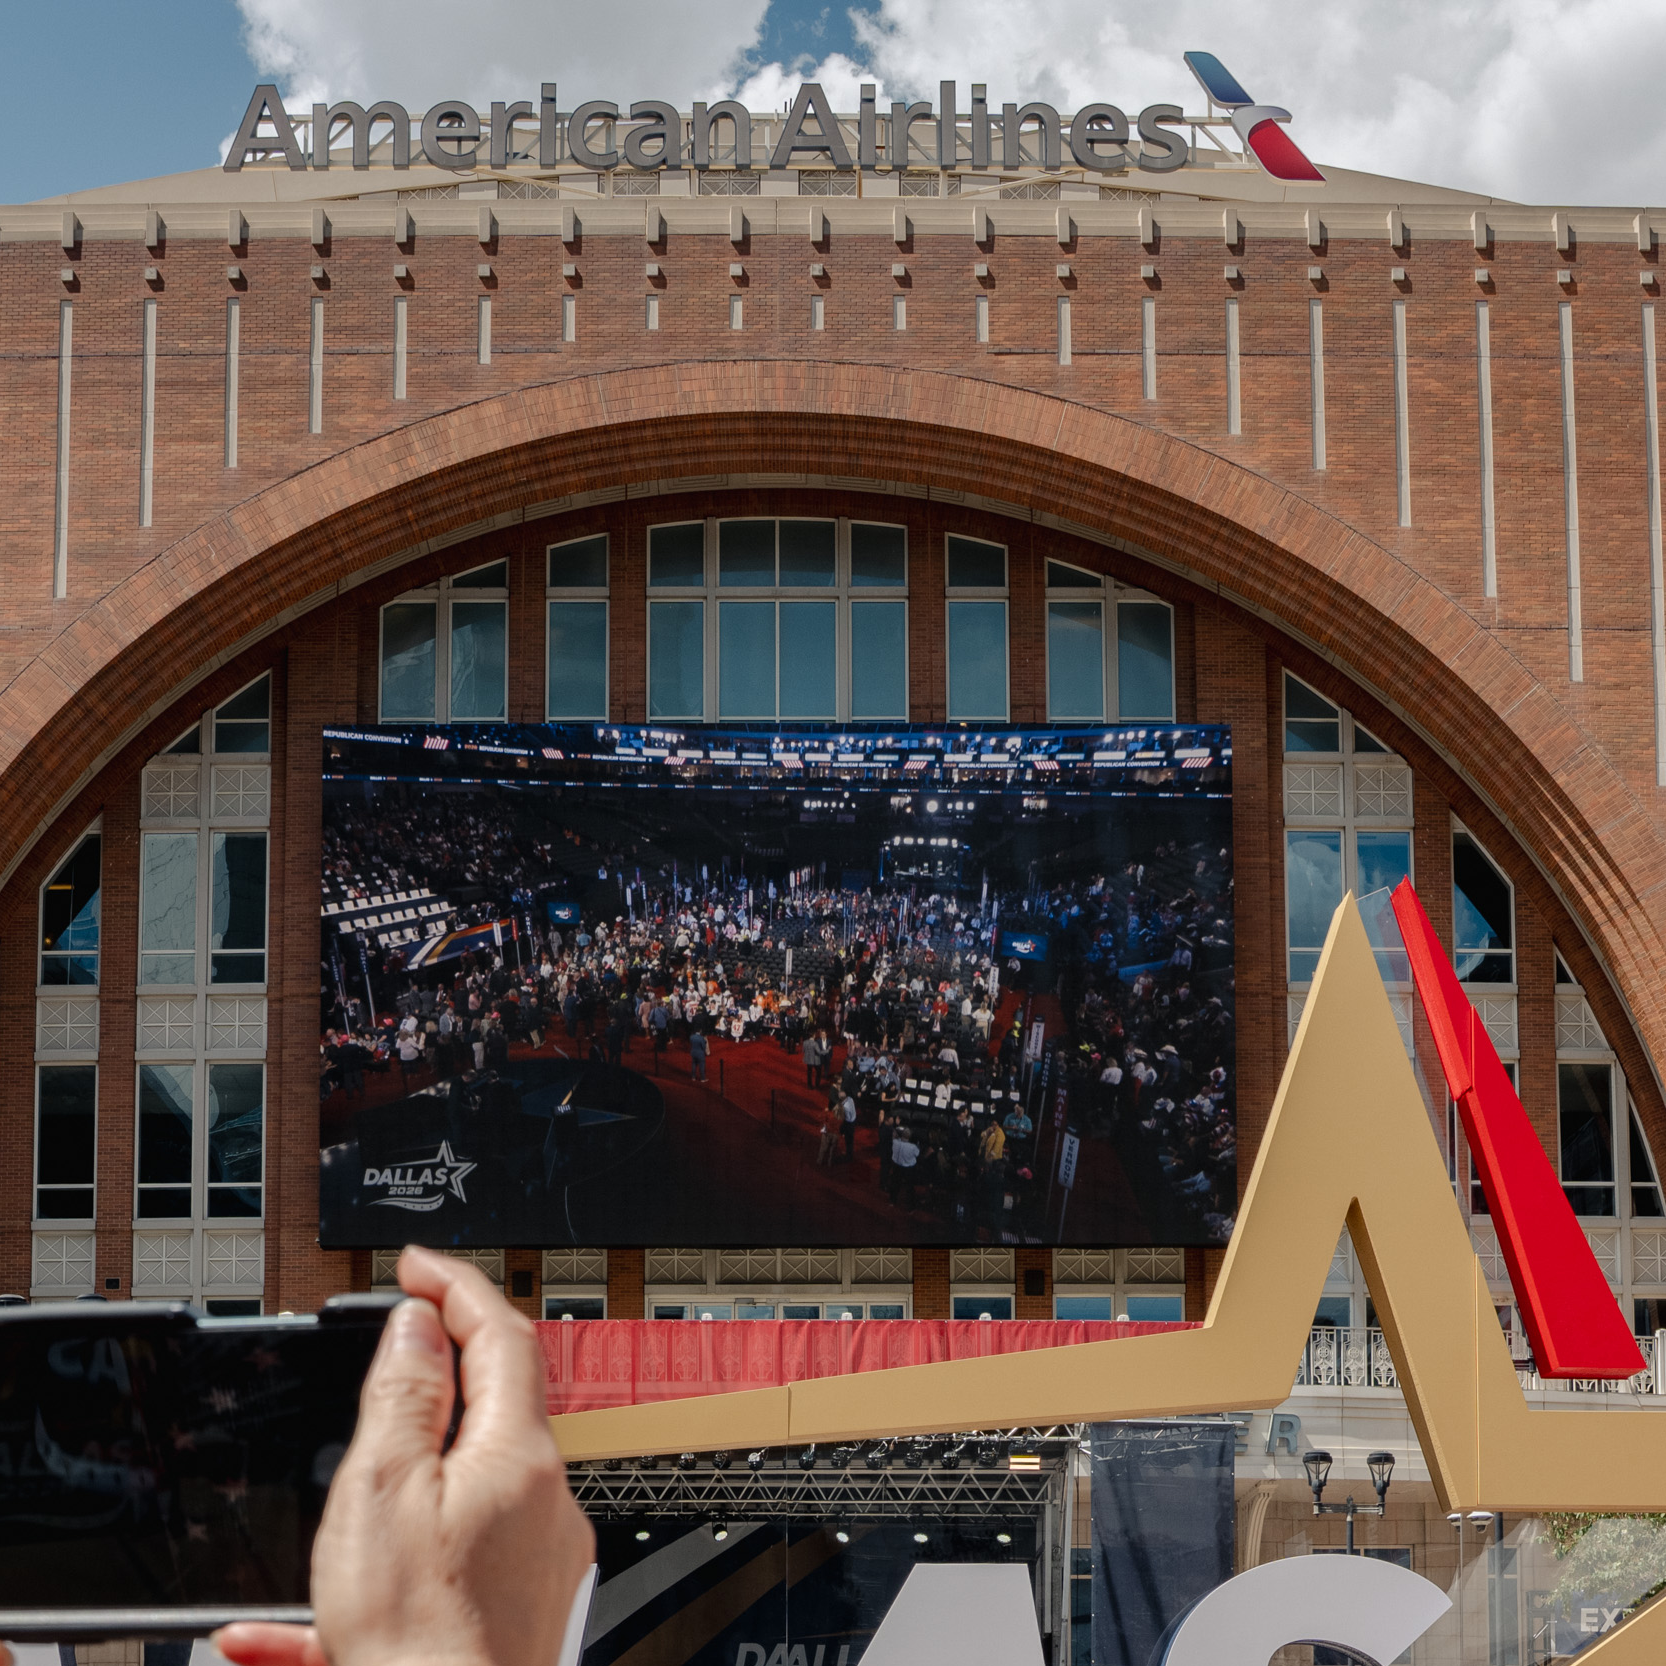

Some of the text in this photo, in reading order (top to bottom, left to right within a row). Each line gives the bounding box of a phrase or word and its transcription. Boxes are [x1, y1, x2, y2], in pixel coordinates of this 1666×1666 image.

[223, 80, 1188, 172] American Airlines
[323, 729, 402, 744] REPUBLICAN CONVENTION
[1041, 1052, 1052, 1087] OREGON
[1054, 1088, 1067, 1128] MAINE
[363, 1168, 448, 1185] DALLAS
[1063, 1138, 1075, 1184] VERMONT
[388, 1186, 423, 1195] 2026
